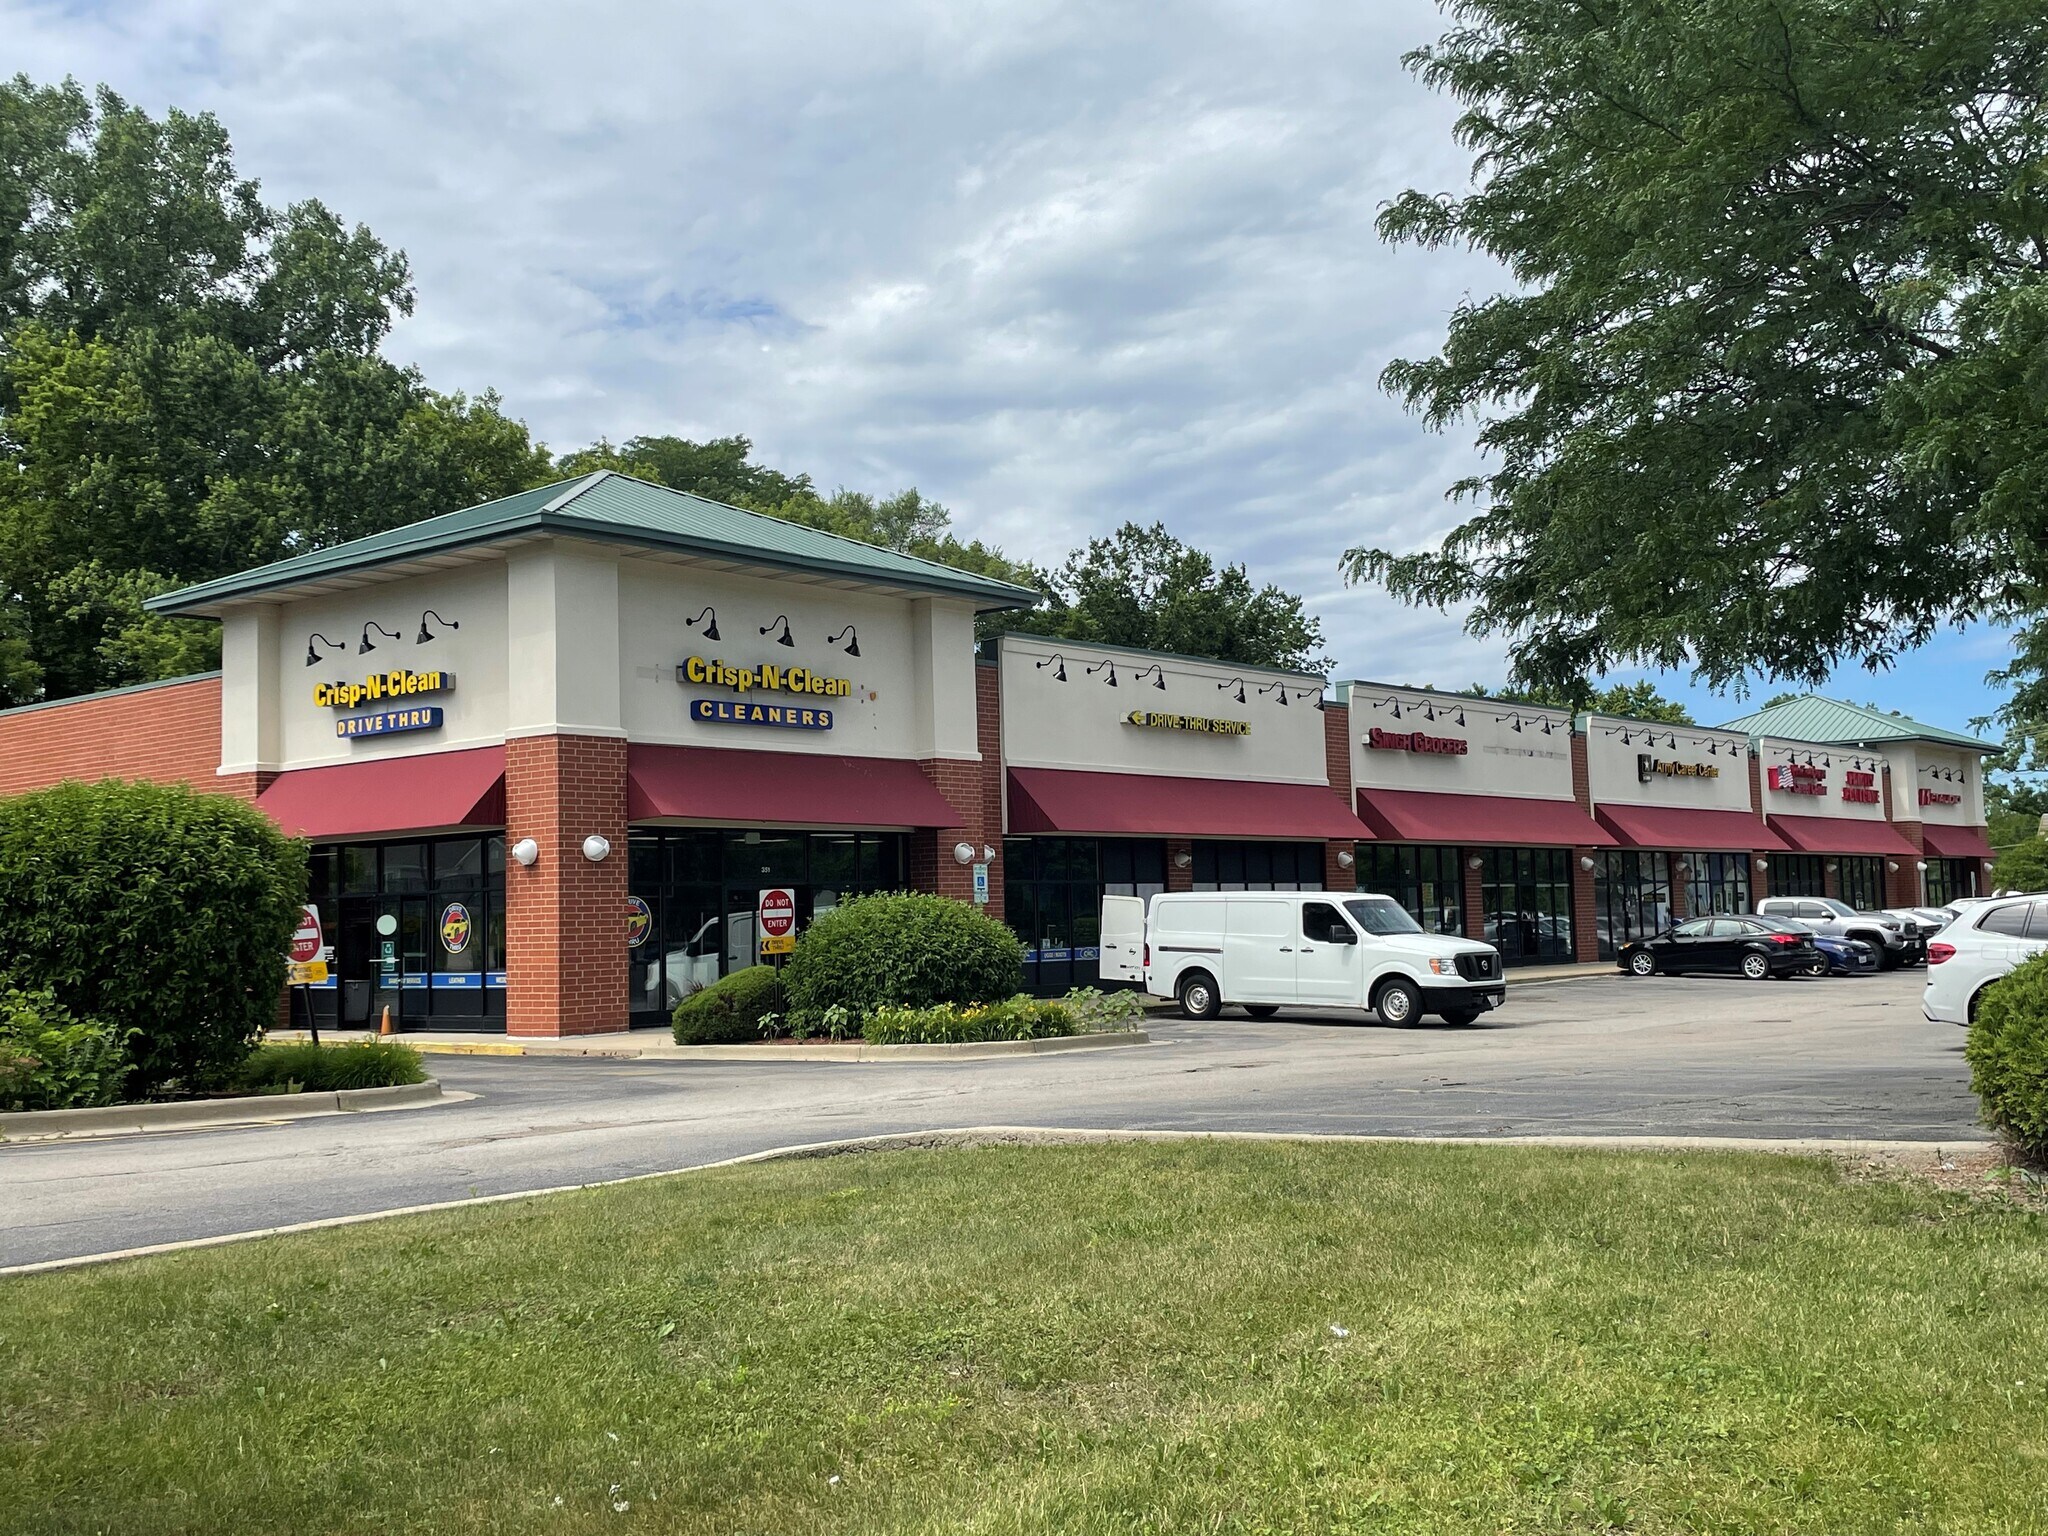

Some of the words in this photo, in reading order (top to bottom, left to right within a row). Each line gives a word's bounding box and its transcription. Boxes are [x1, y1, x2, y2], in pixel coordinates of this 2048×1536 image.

[687, 656, 852, 697] Crisp-N-Clean
[314, 670, 442, 709] Crisp-N-Clean
[337, 716, 383, 736] DRIVE
[388, 709, 431, 728] THRU
[700, 702, 830, 727] CLEANERS
[1150, 712, 1210, 731] DRIVE-THRU
[1212, 719, 1251, 735] SERVICE
[1655, 760, 1676, 777] Army
[1676, 761, 1697, 776] Career
[1698, 763, 1719, 778] Center
[777, 899, 789, 907] NOT
[768, 920, 788, 928] ENTER
[294, 942, 314, 952] NTER
